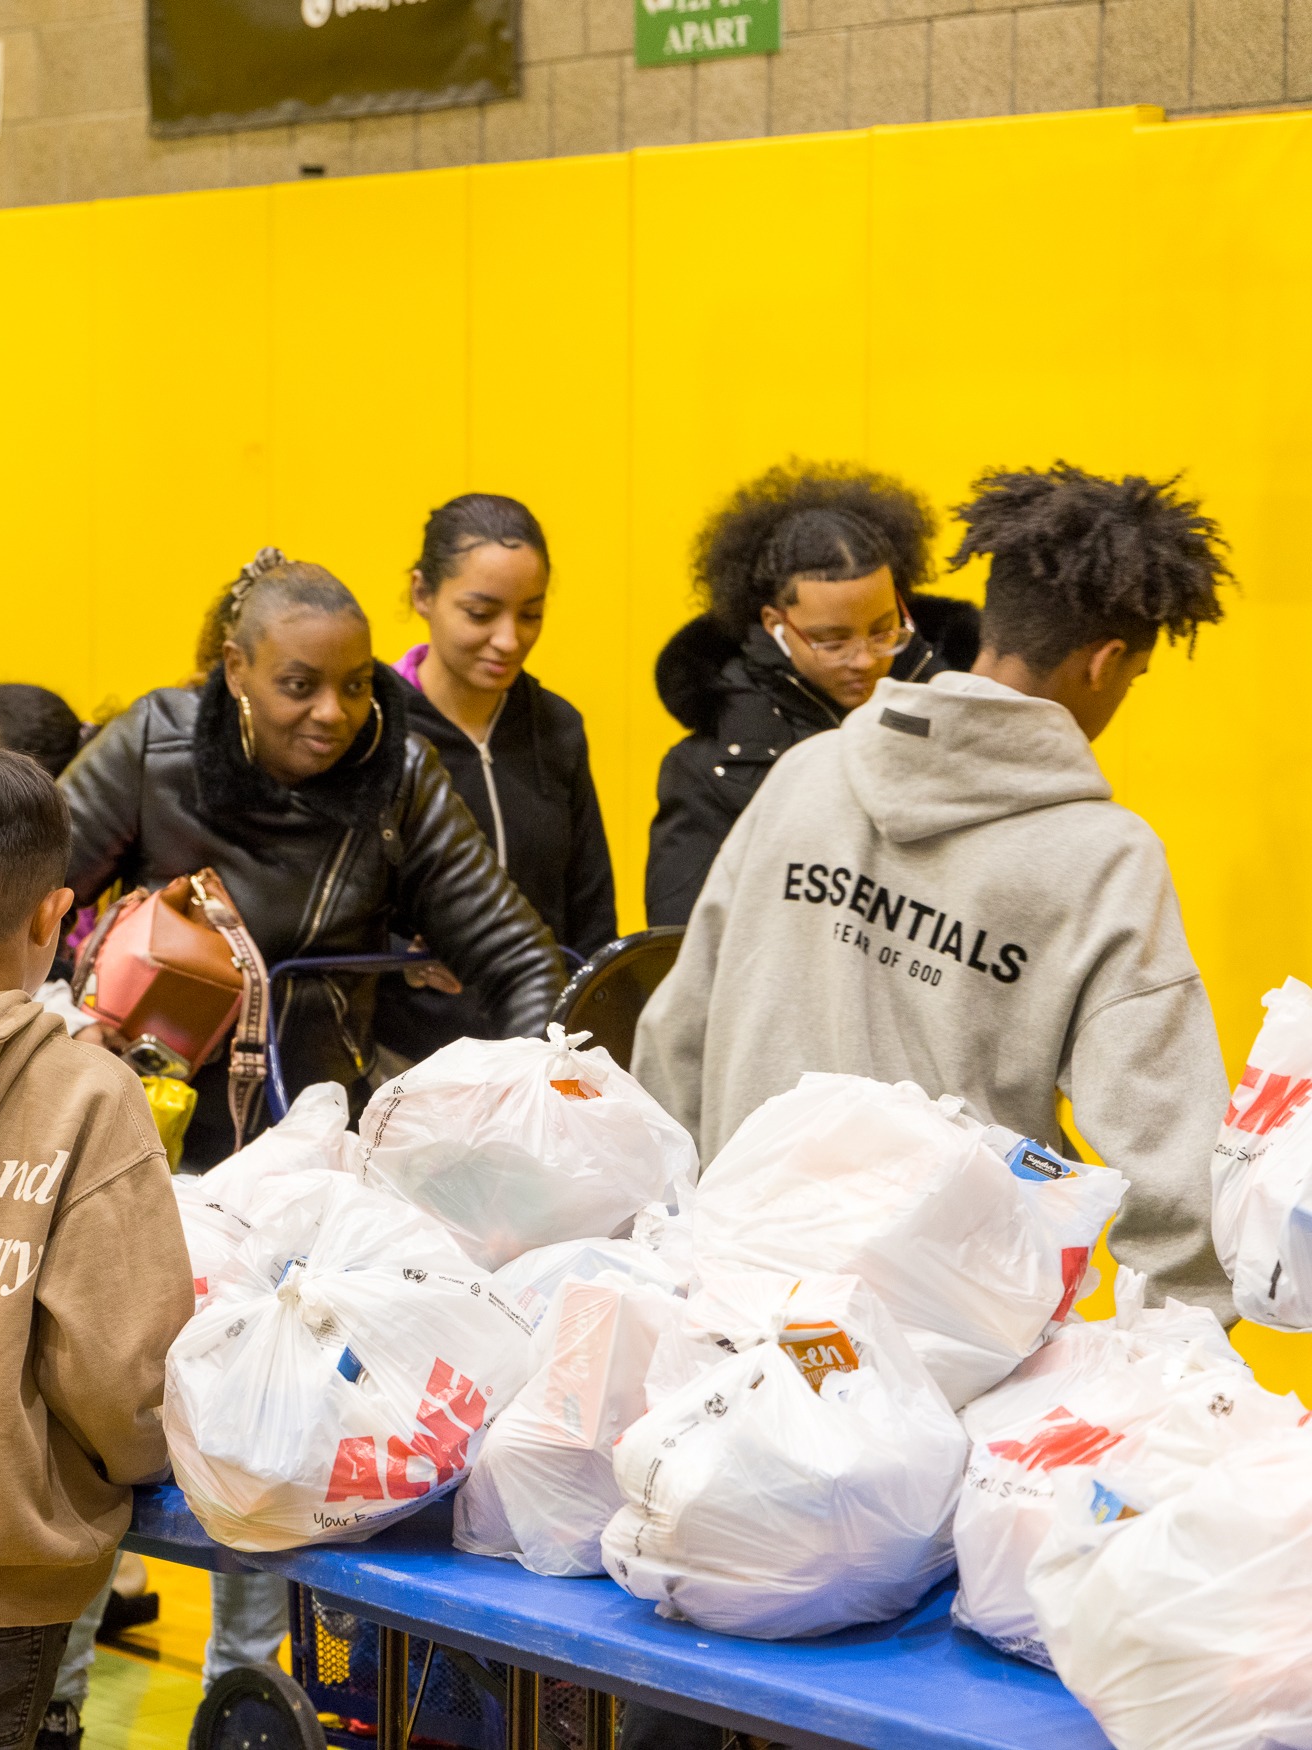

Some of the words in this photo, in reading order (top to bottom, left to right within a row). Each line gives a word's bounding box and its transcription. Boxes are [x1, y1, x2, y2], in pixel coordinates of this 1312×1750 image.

[663, 14, 752, 55] APART
[784, 863, 1028, 984] ESSENTIALS
[833, 922, 870, 955] FEAR
[879, 946, 902, 968] OF
[908, 960, 942, 987] GOD
[314, 1512, 350, 1530] Your
